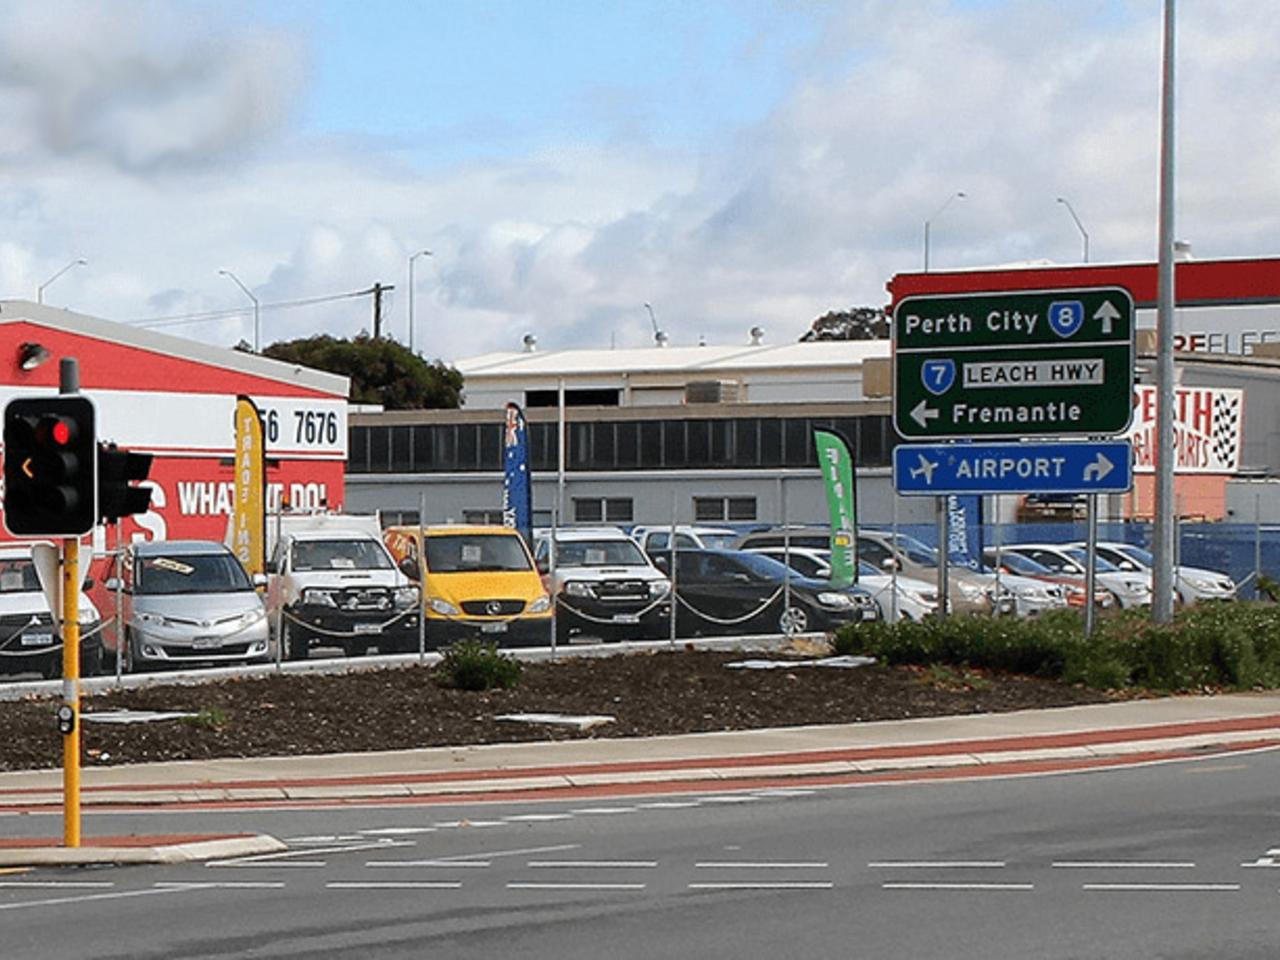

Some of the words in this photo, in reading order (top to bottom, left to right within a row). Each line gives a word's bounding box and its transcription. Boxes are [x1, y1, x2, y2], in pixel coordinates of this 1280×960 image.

[905, 314, 971, 334] Perth
[987, 311, 1038, 334] City
[1058, 307, 1073, 326] 8
[931, 366, 946, 385] 7
[967, 366, 1037, 384] LEACH
[1051, 363, 1099, 381] HWY
[953, 402, 1082, 423] Fremantle
[1133, 390, 1213, 437] ETH
[294, 411, 338, 444] 7676
[956, 458, 1066, 478] AIRPORT
